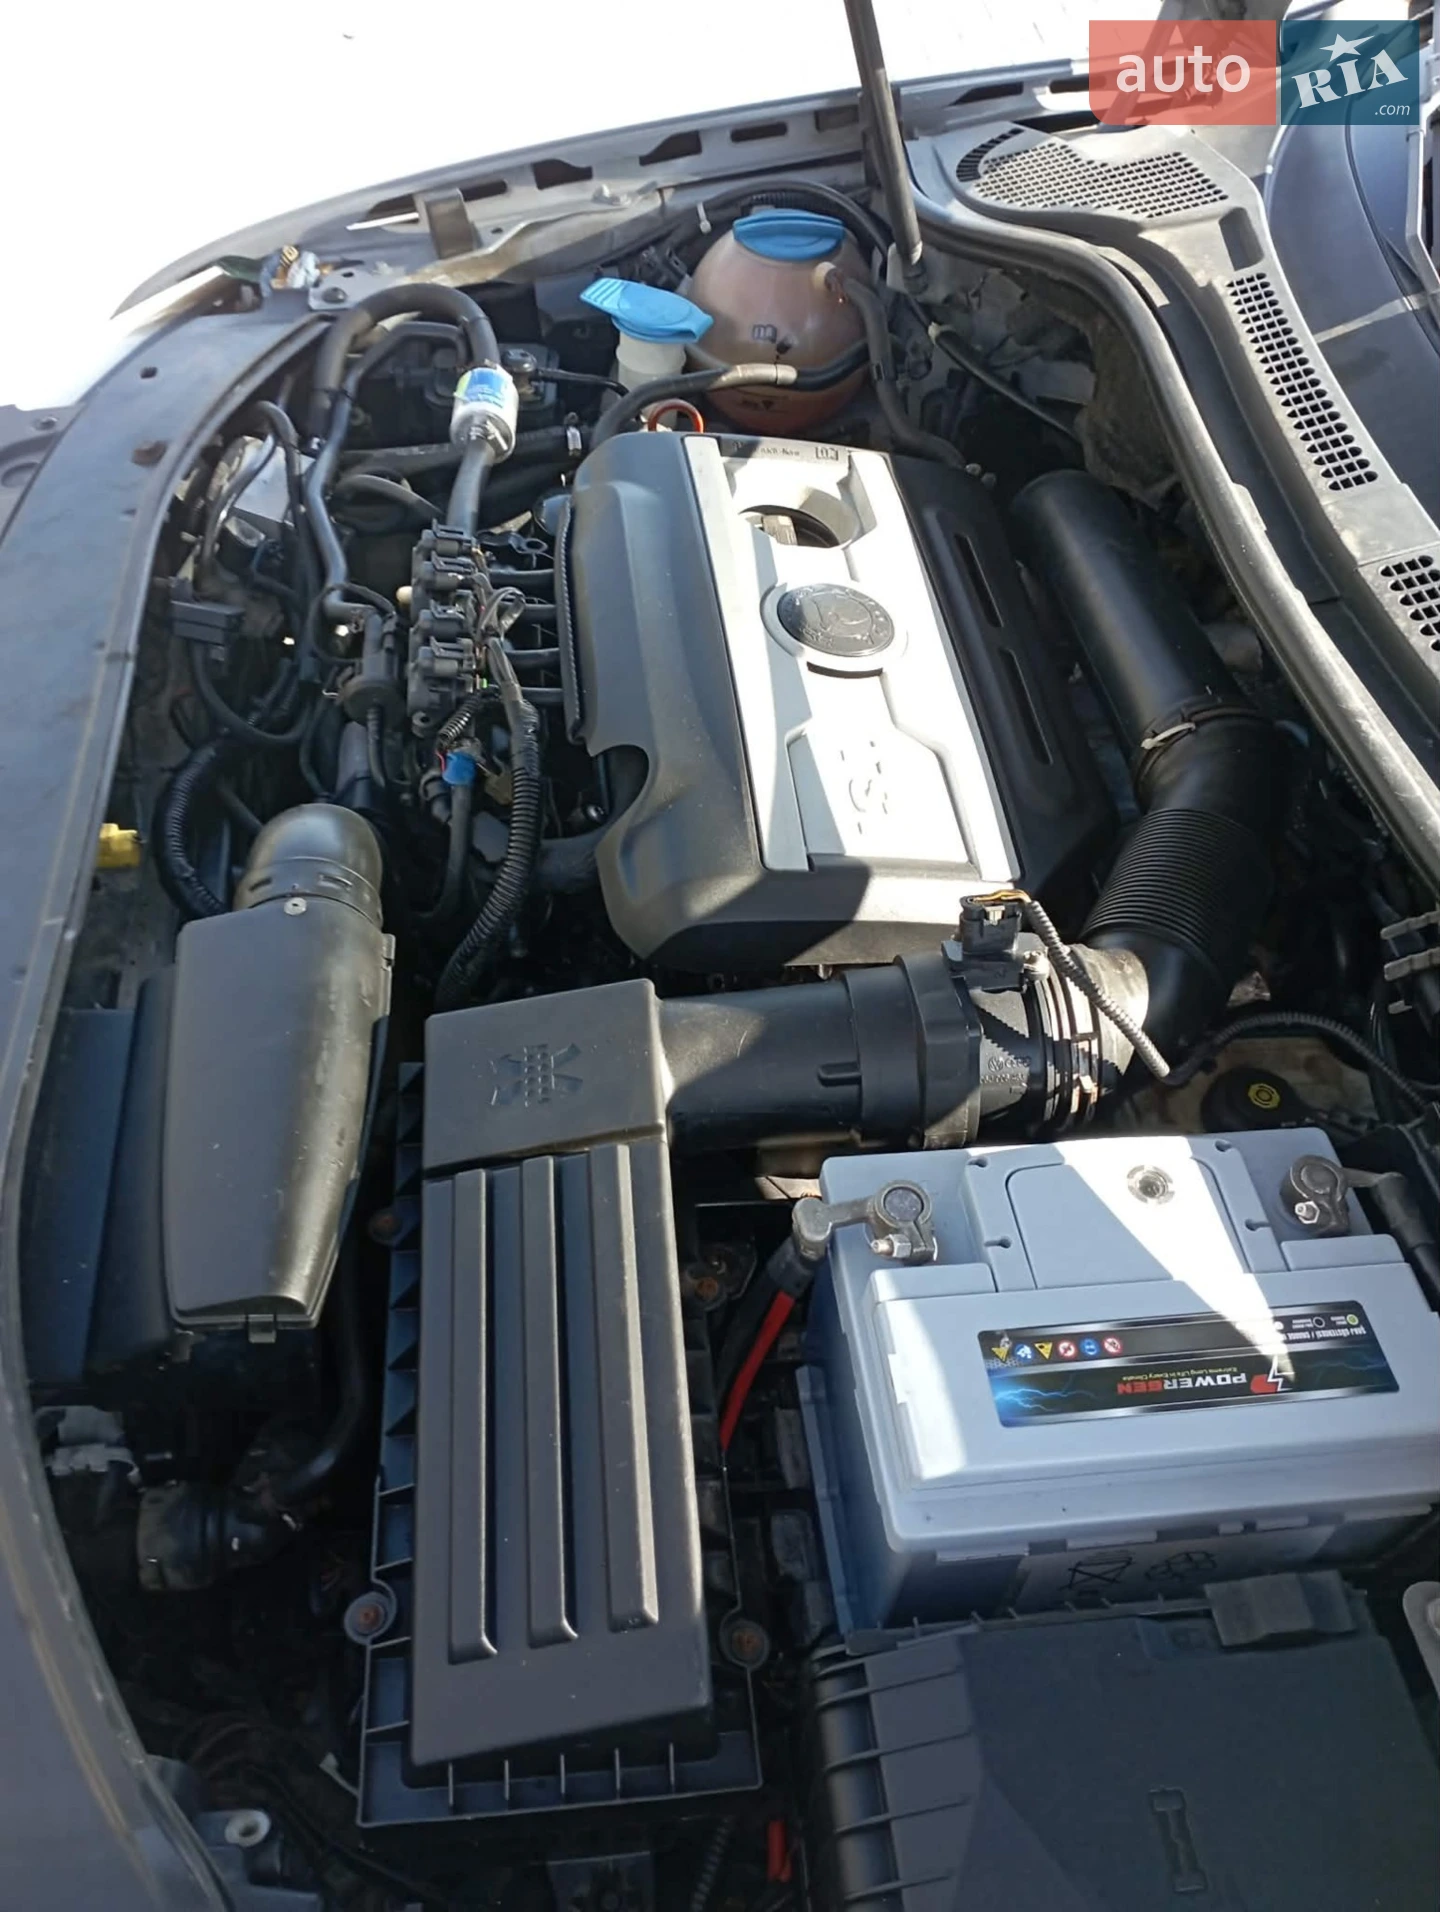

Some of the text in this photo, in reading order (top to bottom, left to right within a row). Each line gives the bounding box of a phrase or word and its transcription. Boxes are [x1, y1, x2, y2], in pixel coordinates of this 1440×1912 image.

[1176, 1370, 1190, 1378] Life
[1190, 1368, 1208, 1377] Long
[1208, 1366, 1238, 1375] Extreme
[1122, 1373, 1148, 1382] Climate
[1148, 1371, 1169, 1380] Every
[1117, 1372, 1247, 1395] POWERGEN
